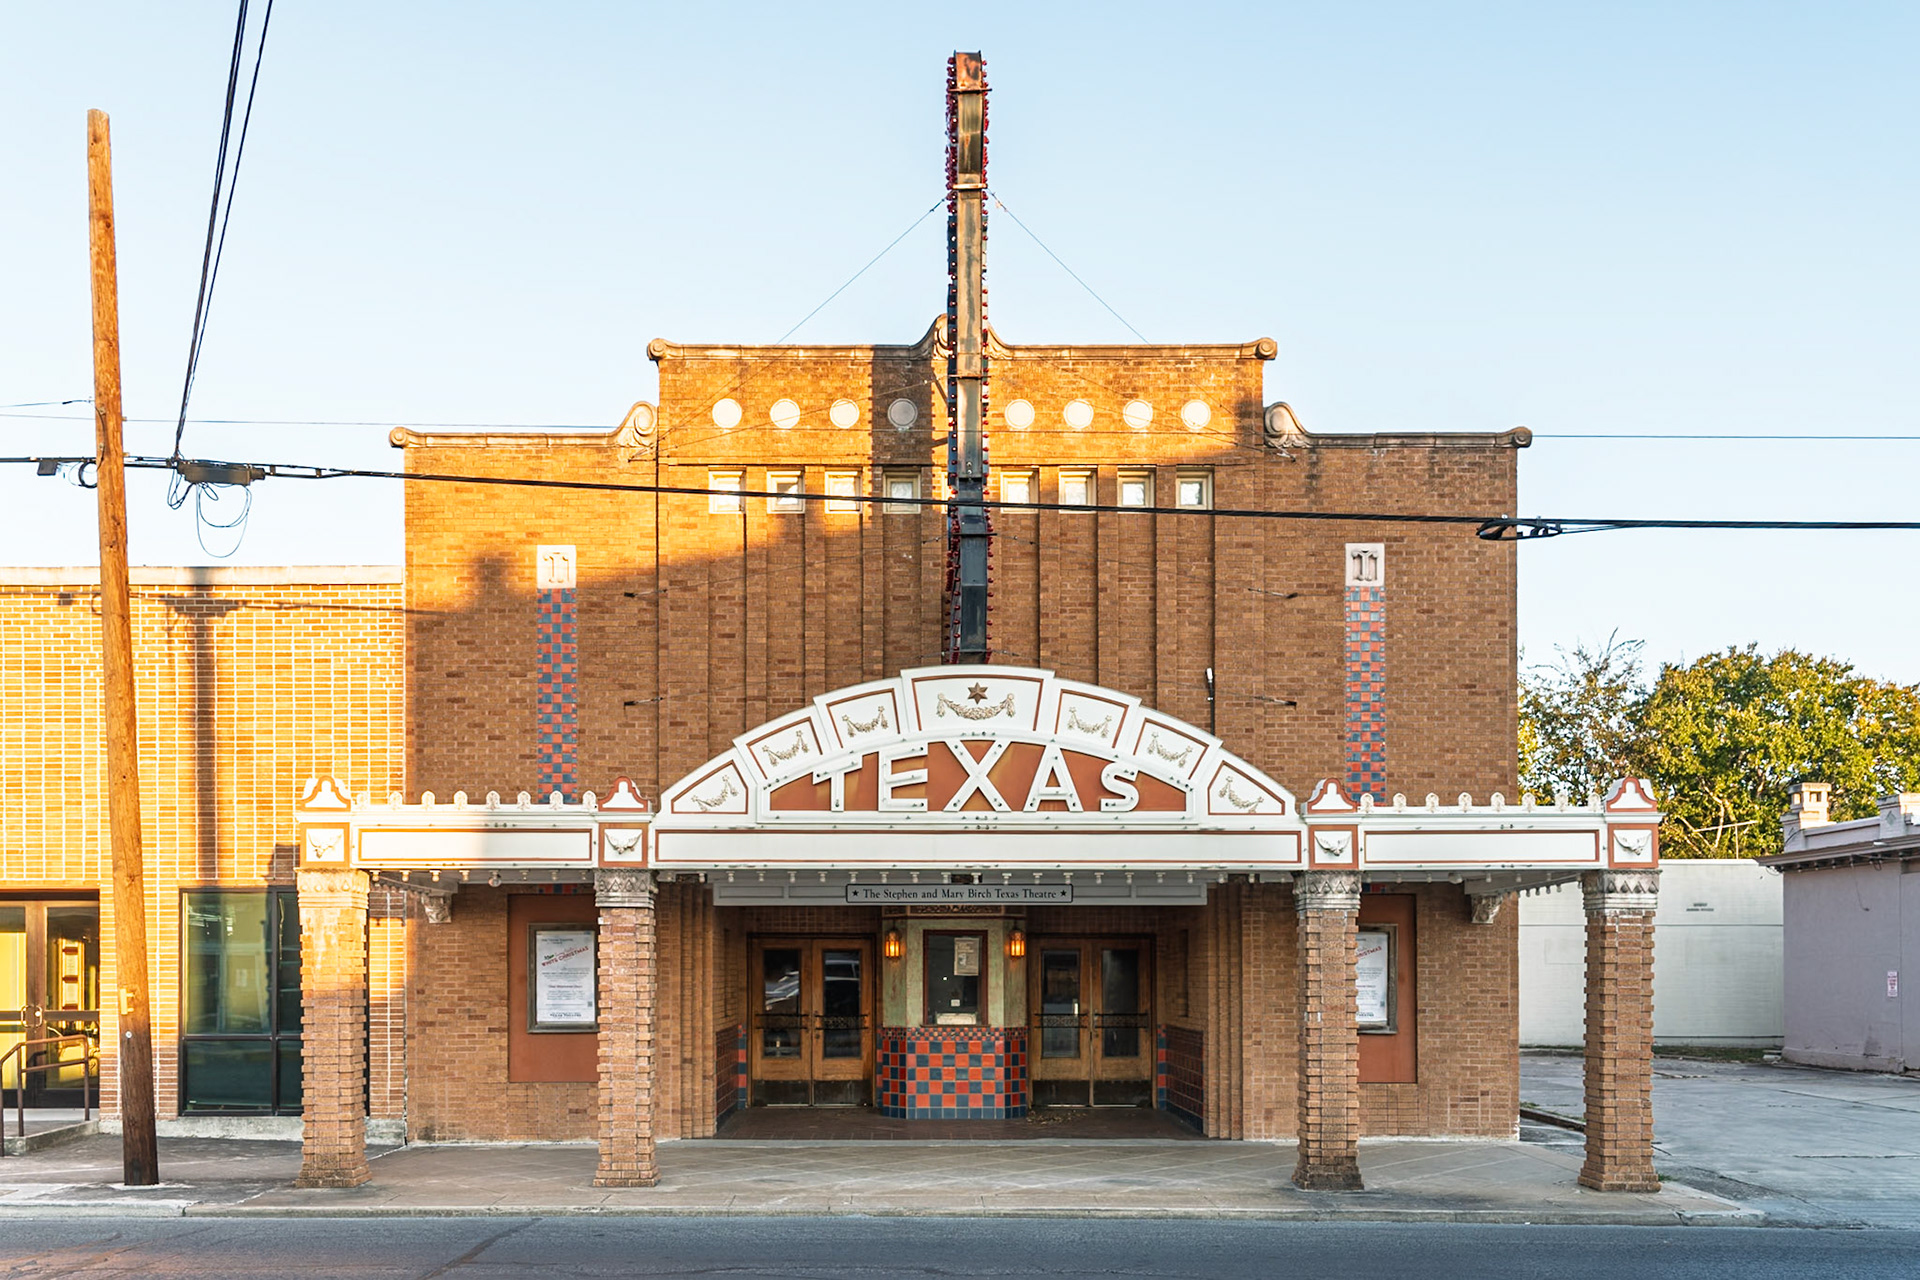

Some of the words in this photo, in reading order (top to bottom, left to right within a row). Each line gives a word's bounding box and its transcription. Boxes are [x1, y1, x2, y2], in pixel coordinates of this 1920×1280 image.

[812, 741, 1140, 812] TEXAS
[863, 888, 881, 899] The
[883, 888, 918, 900] Stephen
[921, 888, 938, 899] and
[941, 888, 965, 899] Mary
[968, 888, 992, 899] Birch
[994, 888, 1020, 899] Texas
[1022, 888, 1057, 899] Theatre
[558, 946, 589, 960] CHRISTMAS
